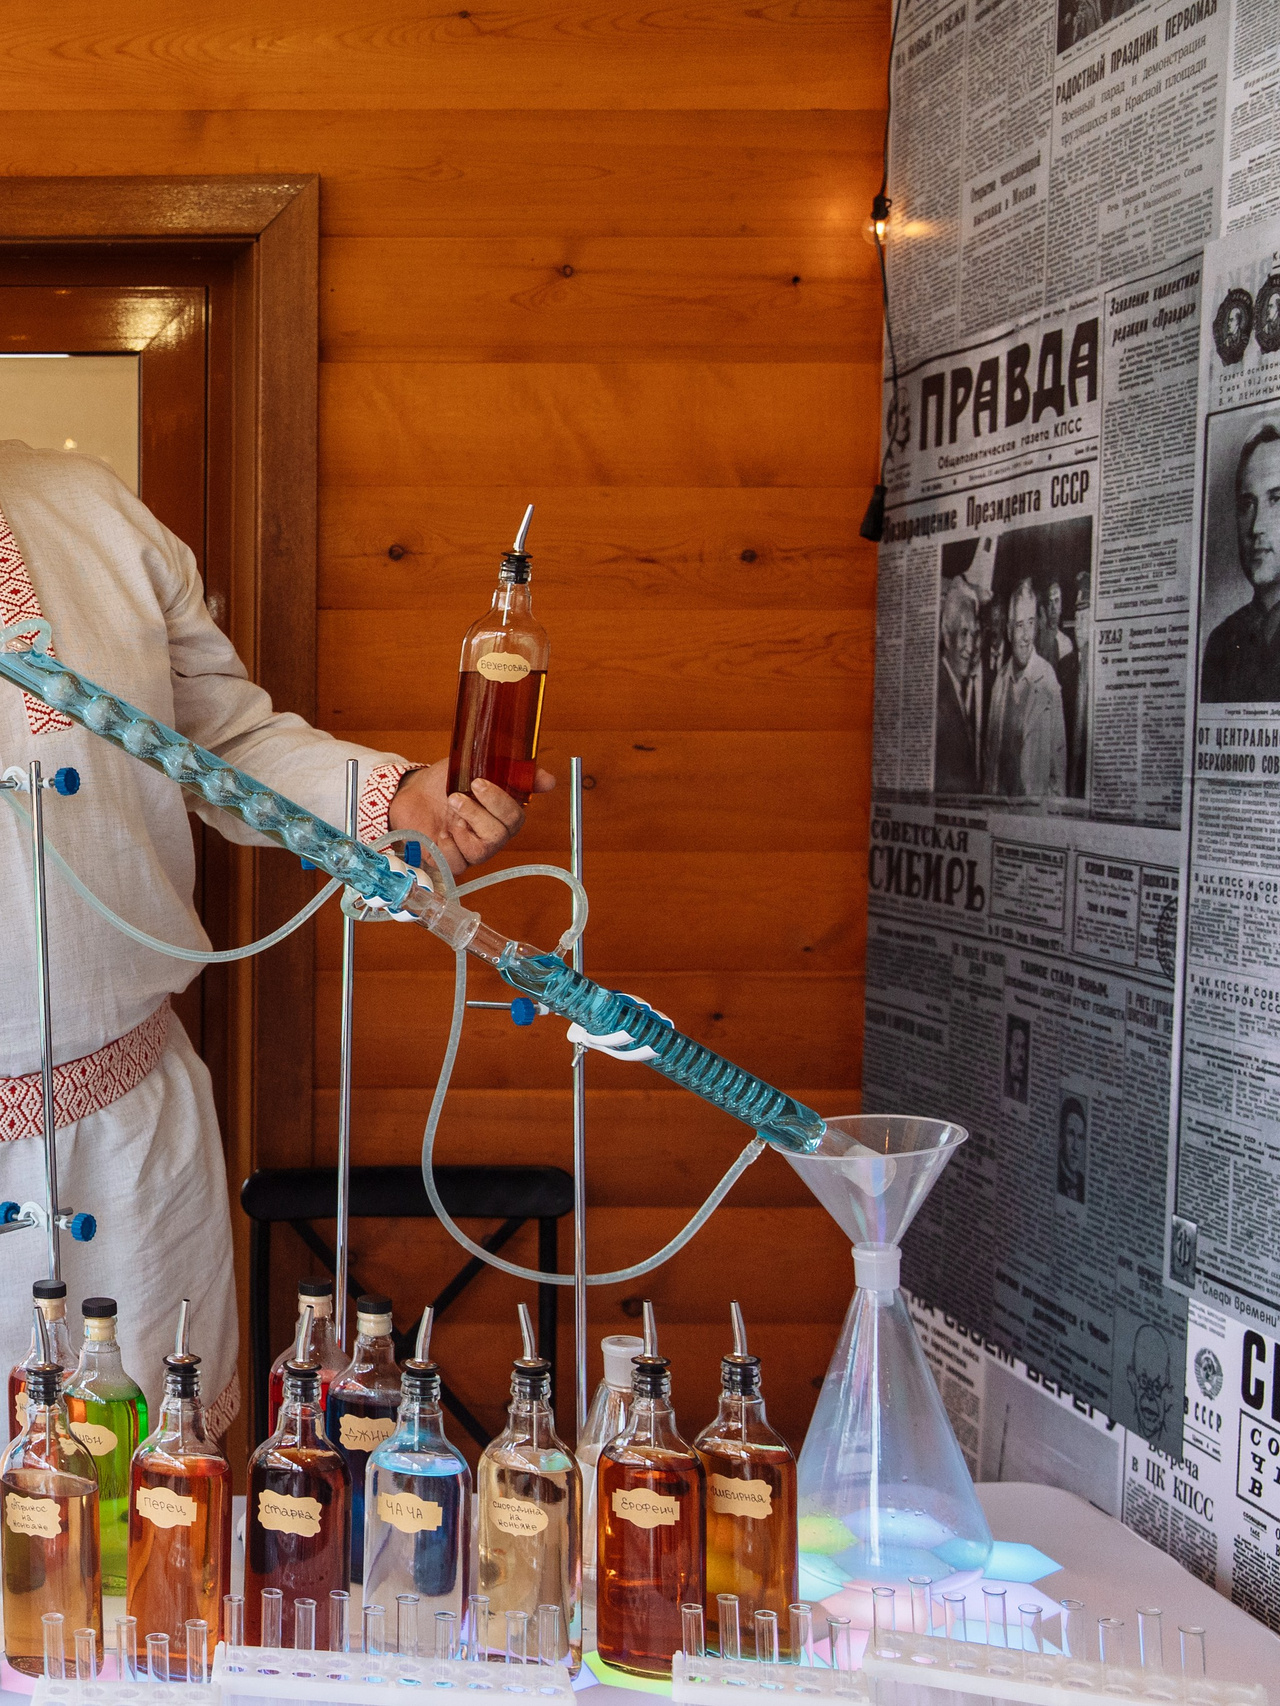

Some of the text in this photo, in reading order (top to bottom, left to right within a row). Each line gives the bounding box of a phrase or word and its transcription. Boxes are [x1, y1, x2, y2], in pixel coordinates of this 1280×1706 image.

[1055, 54, 1106, 106] РАДОСТНЫЙ
[1111, 25, 1159, 73] ПРАЗДНИК
[1165, 0, 1218, 42] ПЕРВОМАЯ
[1061, 34, 1207, 126] Военный парад и демонстрация
[1061, 57, 1208, 148] трудящихся на Красной площади
[1109, 290, 1150, 317] Заявление
[1152, 269, 1200, 302] коллектива
[1111, 302, 1196, 347] редакции «Правды»
[919, 316, 1100, 451] ПРАВДА
[1220, 371, 1244, 384] Газета
[1243, 376, 1262, 389] 1912
[937, 441, 1016, 470] Общеполитическая
[1020, 429, 1050, 448] газета
[1053, 417, 1083, 438] КПСС
[966, 489, 1041, 530] Президента
[1050, 469, 1089, 509] СССР
[1099, 628, 1123, 645] УКАЗ
[480, 659, 528, 673] Бехеровка
[1198, 727, 1280, 749] ОТ ЦЕНТРАЛЬН
[1198, 752, 1280, 774] ВЕРХОВНОГО СОВ
[871, 818, 969, 853] СОВЕТСКАЯ
[869, 845, 985, 913] СИБИРЬ
[1203, 874, 1215, 884] ЦК
[1219, 875, 1243, 888] КПСС
[1248, 880, 1254, 889] И
[1198, 885, 1259, 902] МИНИСТРОВ
[1193, 985, 1254, 1007] МИНИСТРОВ
[1199, 976, 1210, 986] ЦК
[1214, 978, 1239, 992] КПСС
[1243, 985, 1249, 994] И
[1195, 1402, 1223, 1433] СССР
[1131, 1456, 1214, 1522] в ЦК КПСС
[143, 1496, 187, 1516] Перец
[509, 1512, 523, 1522] на
[621, 1497, 675, 1516] Ерофеич
[22, 1514, 34, 1522] на
